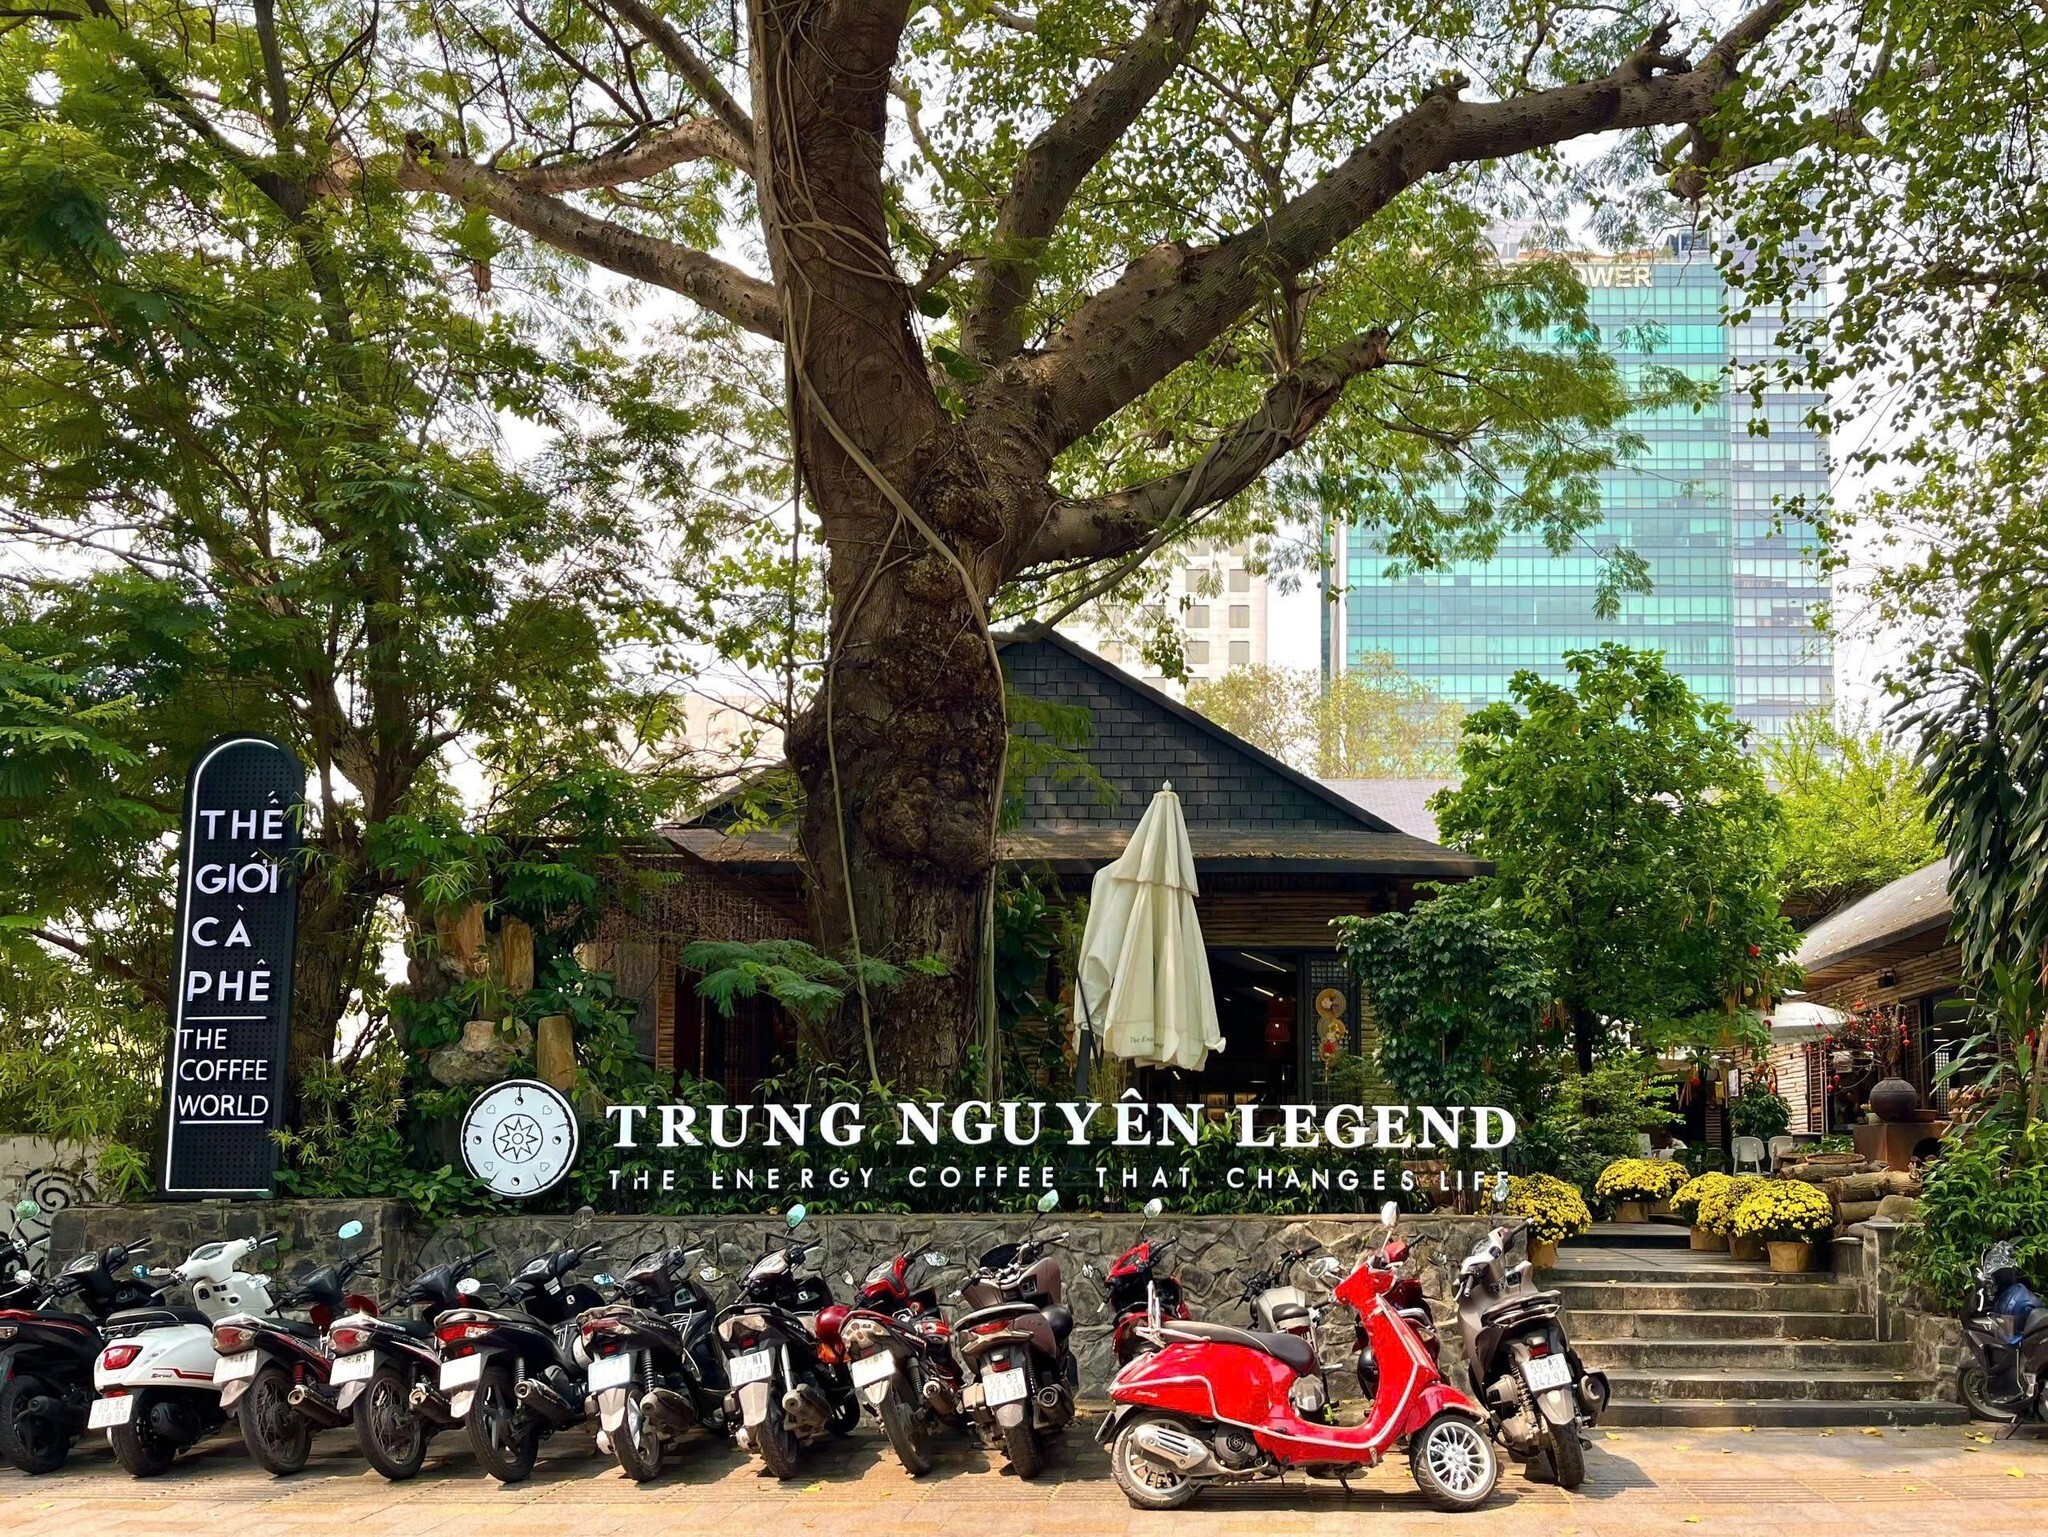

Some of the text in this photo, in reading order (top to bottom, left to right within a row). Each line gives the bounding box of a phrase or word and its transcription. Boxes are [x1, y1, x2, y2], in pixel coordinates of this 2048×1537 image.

[1571, 266, 1653, 288] OWER
[199, 790, 283, 840] THẾ
[195, 851, 278, 895] GIỚI
[191, 904, 252, 947] CÀ
[186, 958, 271, 1002] PHÊ
[179, 1028, 228, 1050] THE
[179, 1058, 268, 1081] COFFEE
[177, 1094, 269, 1116] WORLD
[605, 1087, 1516, 1149] TRUNG NGUYÊN LEGEND
[608, 1169, 675, 1190] THE
[712, 1166, 873, 1190] ENERGY
[908, 1166, 1055, 1188] COFFEE
[1095, 1166, 1191, 1188] THAT
[1226, 1166, 1415, 1191] CHANGES
